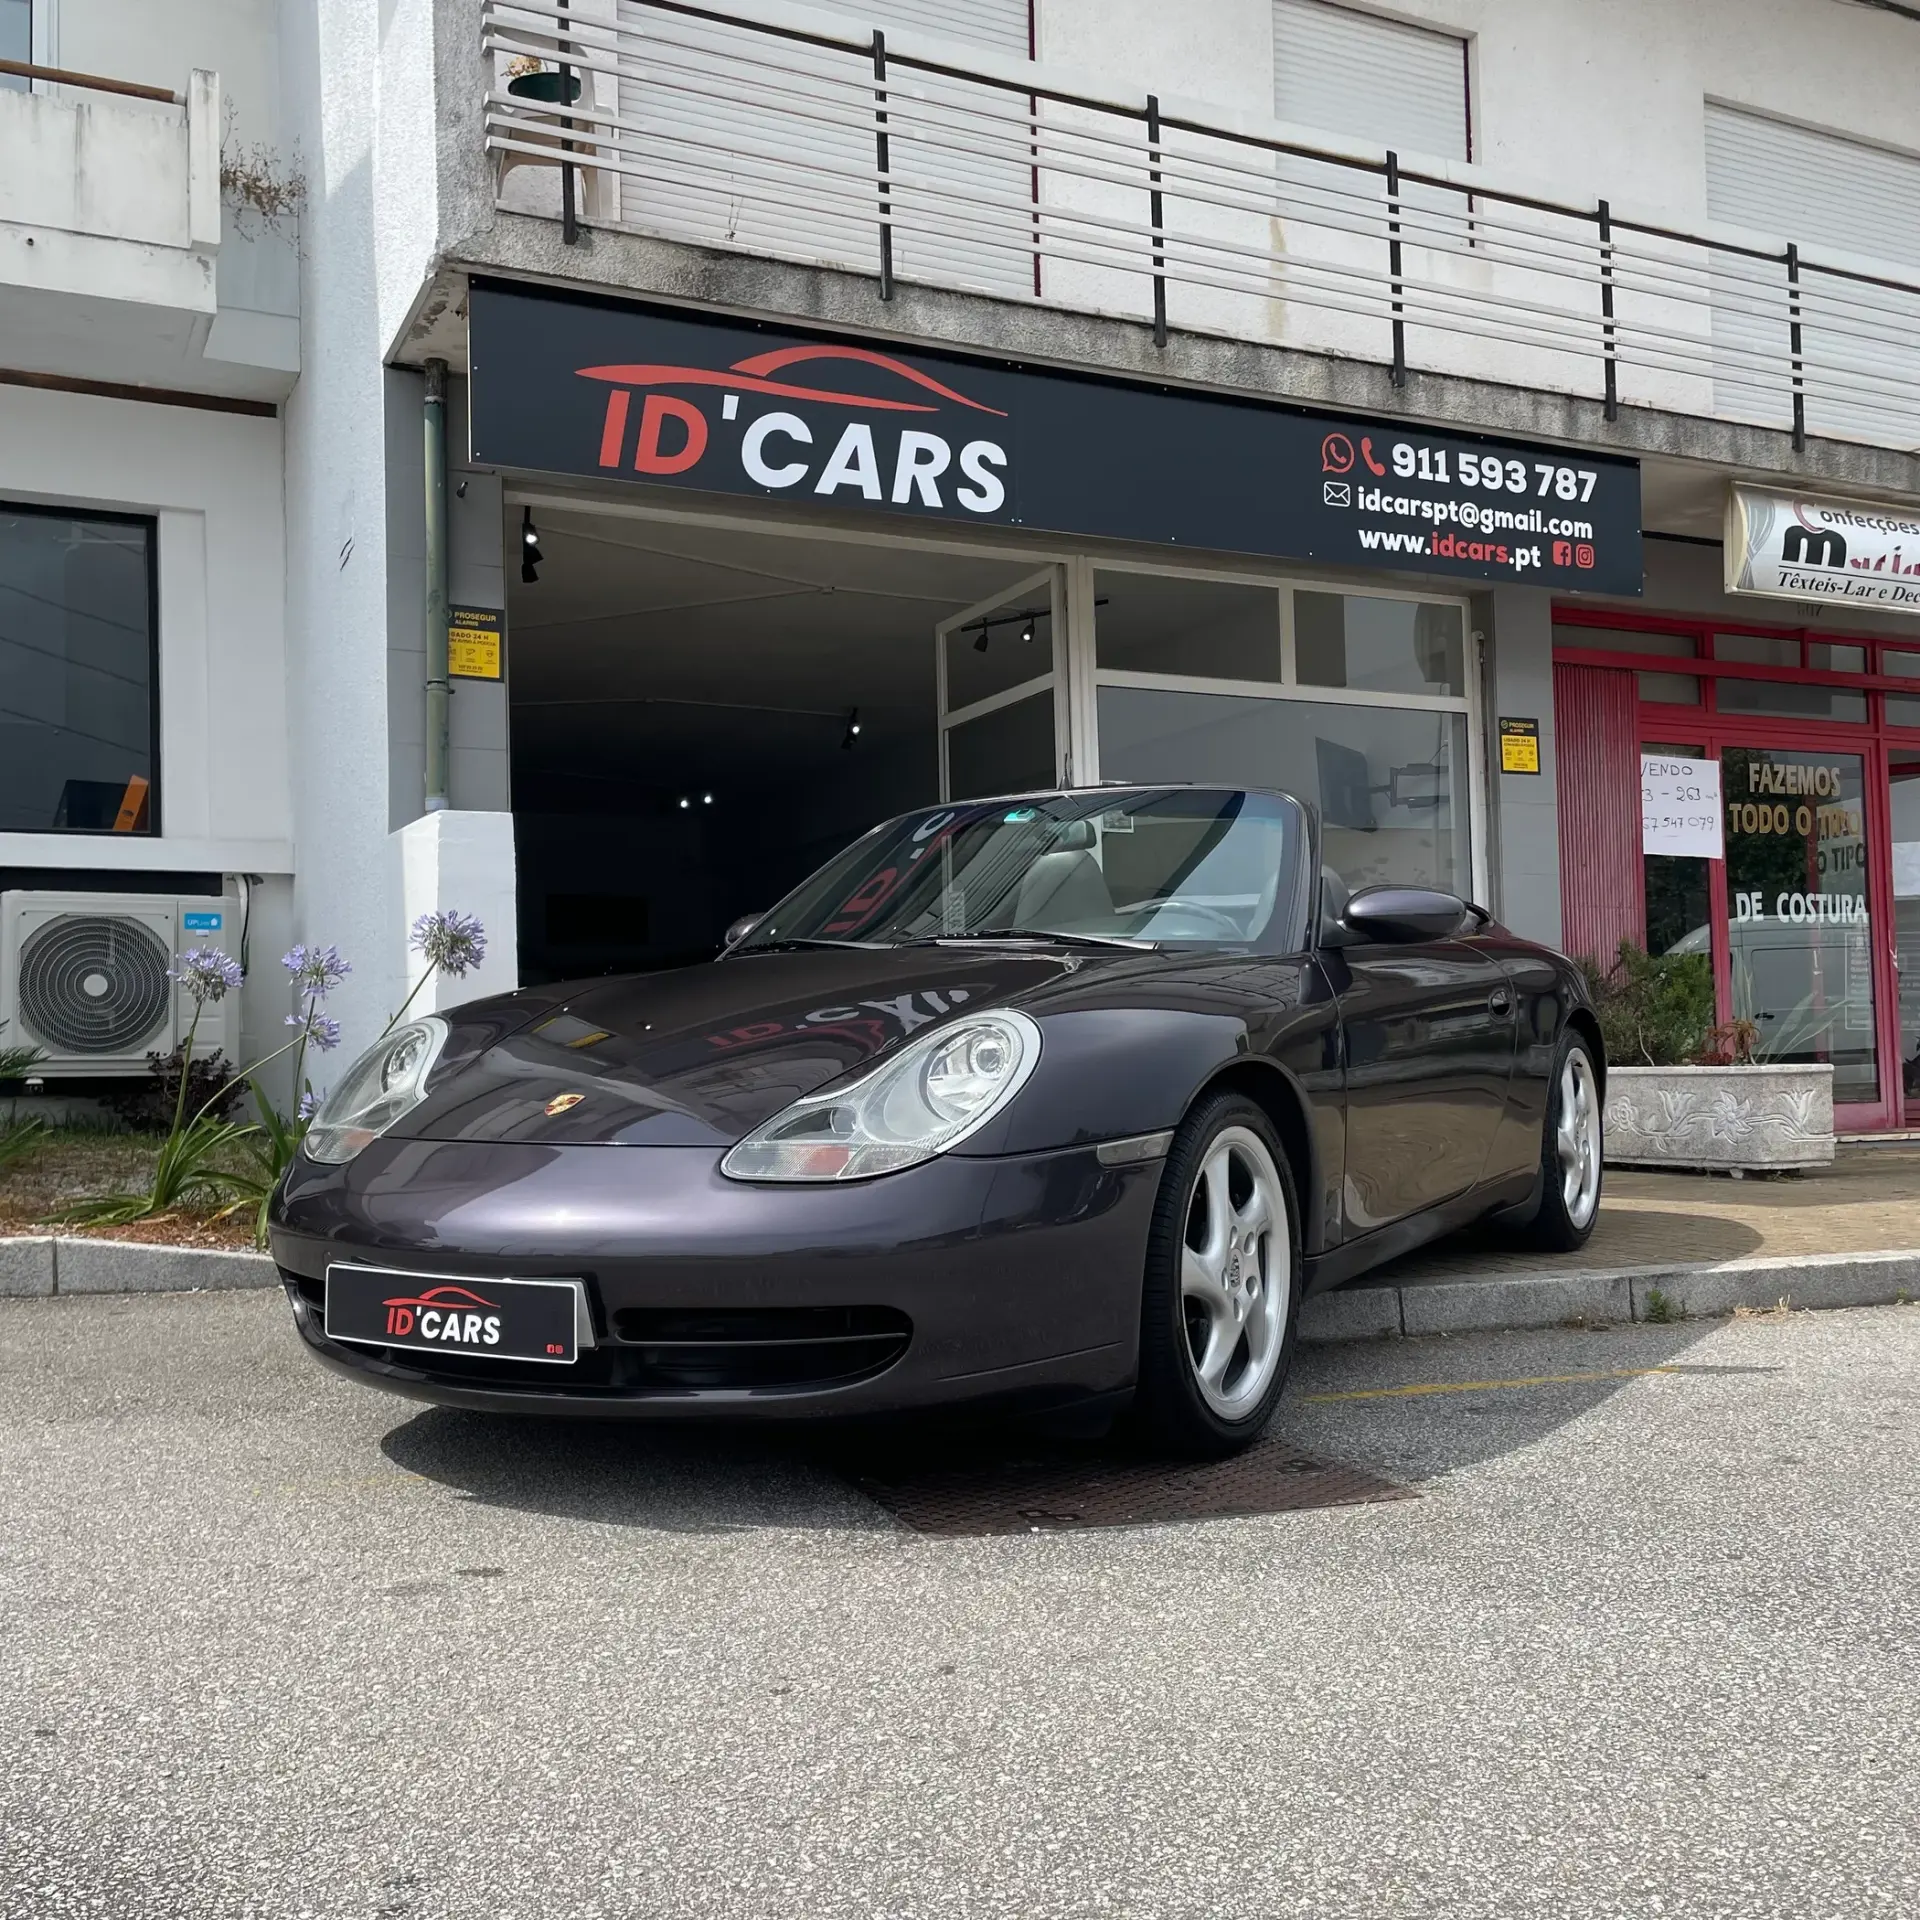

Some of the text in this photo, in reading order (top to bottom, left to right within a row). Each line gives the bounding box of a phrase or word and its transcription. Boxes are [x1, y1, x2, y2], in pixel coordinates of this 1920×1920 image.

[600, 389, 1007, 512] ID'CARS
[1392, 443, 1597, 503] 911 593 787
[1357, 486, 1593, 540] idcarspt@gmail.com
[1358, 529, 1541, 571] www.idcars.pt
[1778, 571, 1875, 598] Têxteis-Lar
[1878, 589, 1888, 599] e
[454, 611, 497, 622] PROSEGUR
[1676, 786, 1701, 801] 263
[1749, 763, 1840, 797] FAZEMOS
[1661, 817, 1684, 828] 547
[1729, 804, 1789, 835] TODO
[1795, 806, 1811, 836] O
[1736, 892, 1869, 924] DE COSTURA
[386, 1306, 500, 1345] ID'CARS
